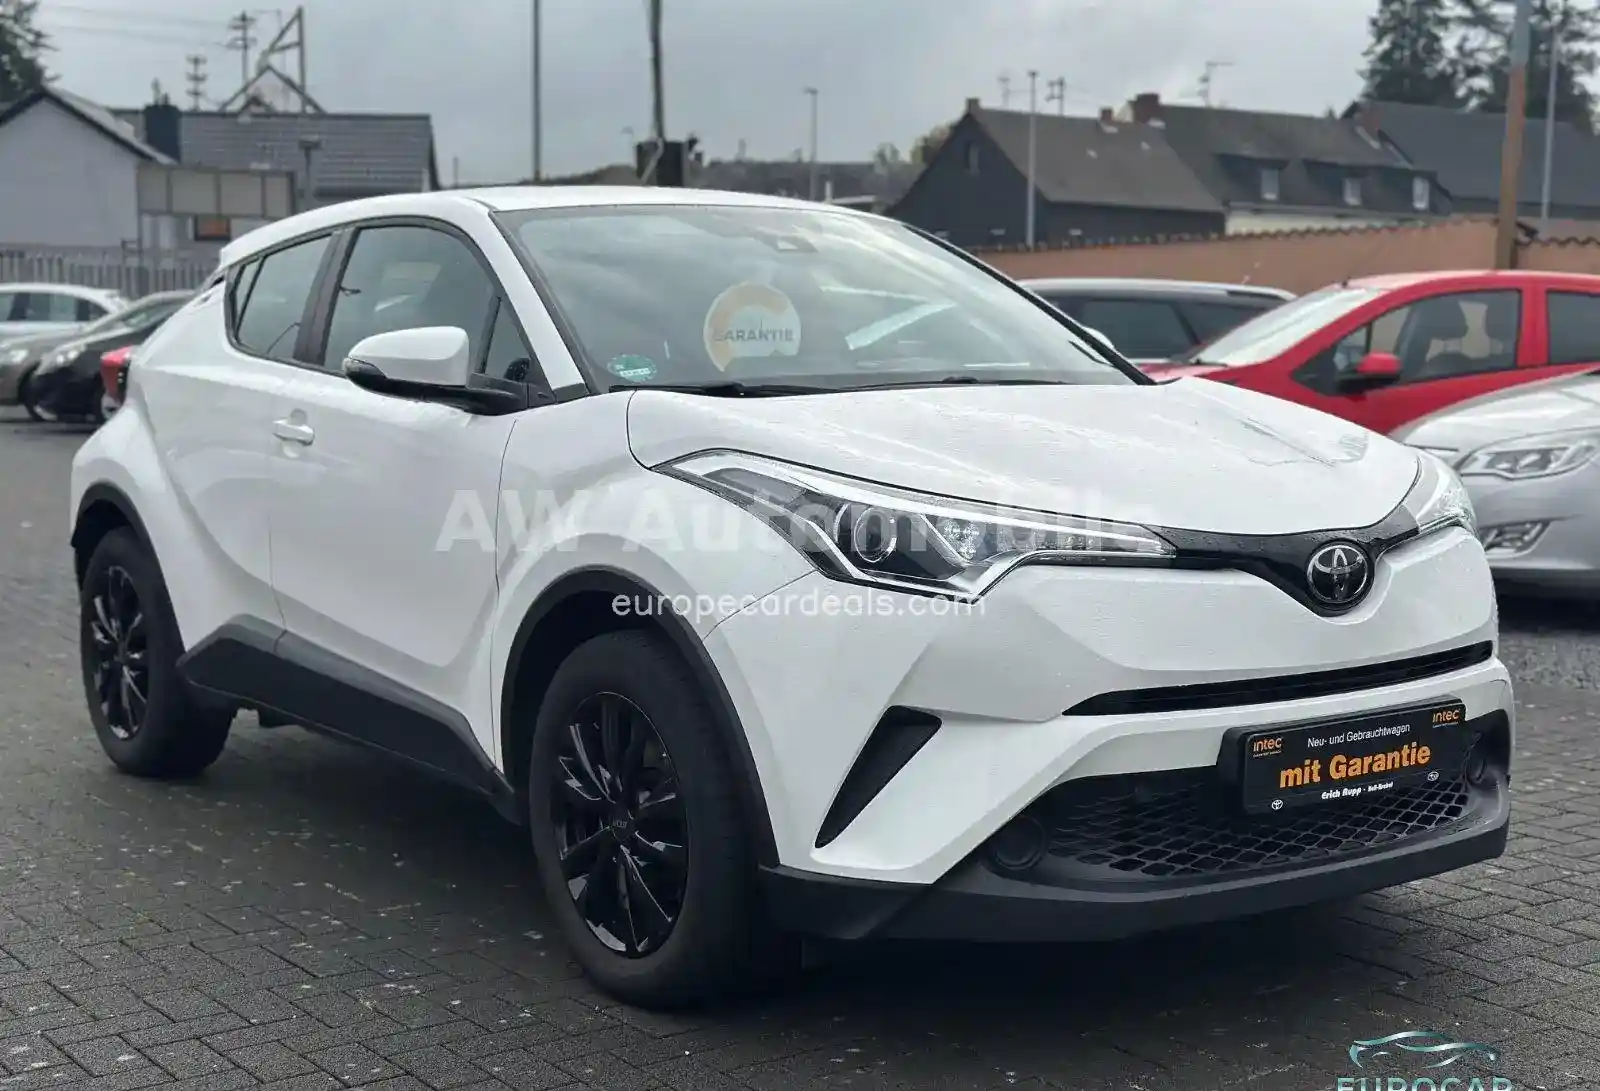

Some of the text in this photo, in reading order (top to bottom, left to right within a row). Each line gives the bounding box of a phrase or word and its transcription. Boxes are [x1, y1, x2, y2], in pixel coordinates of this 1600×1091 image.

[1253, 737, 1283, 752] intec
[1307, 724, 1411, 749] Neu- und Gebrauchtwagen
[1279, 741, 1432, 788] mit Garantie
[1321, 789, 1341, 800] Erich
